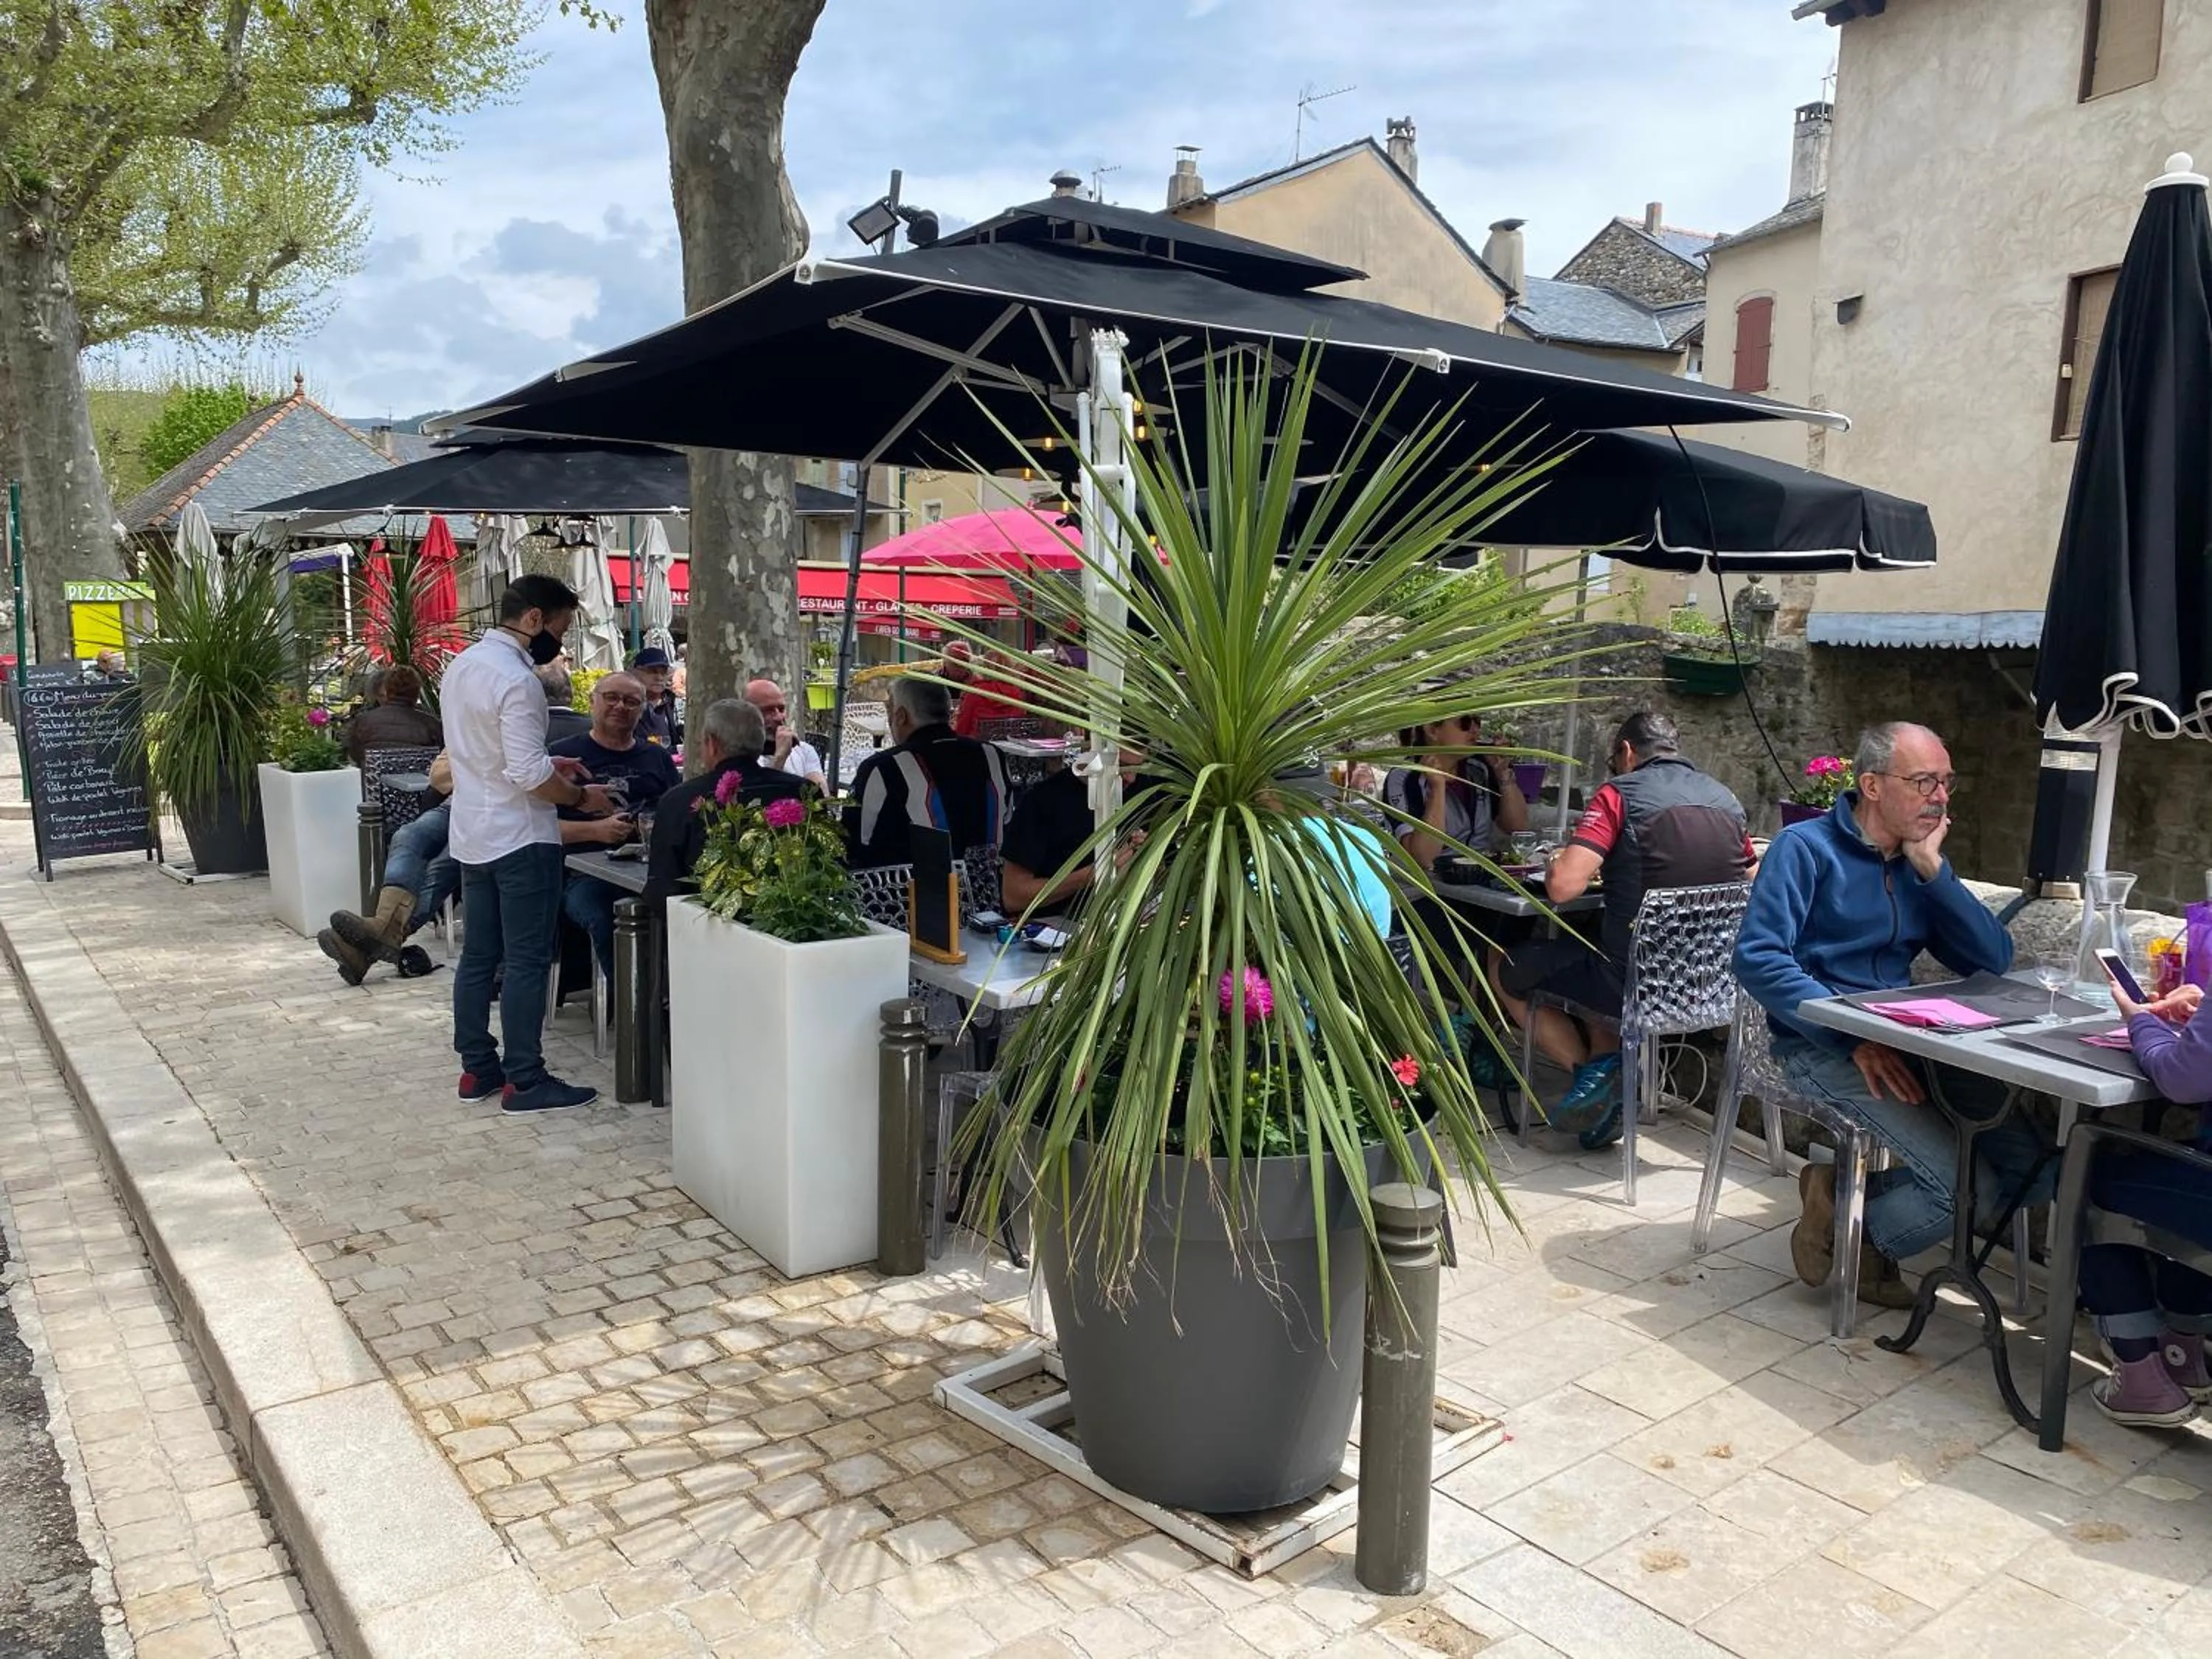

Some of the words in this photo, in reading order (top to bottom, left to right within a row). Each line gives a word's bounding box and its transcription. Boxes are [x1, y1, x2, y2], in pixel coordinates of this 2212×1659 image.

[796, 597, 868, 611] ESTAURNT
[931, 604, 982, 615] CREPERIE
[33, 707, 72, 718] Salade
[35, 720, 75, 730] Salade
[71, 768, 83, 777] de
